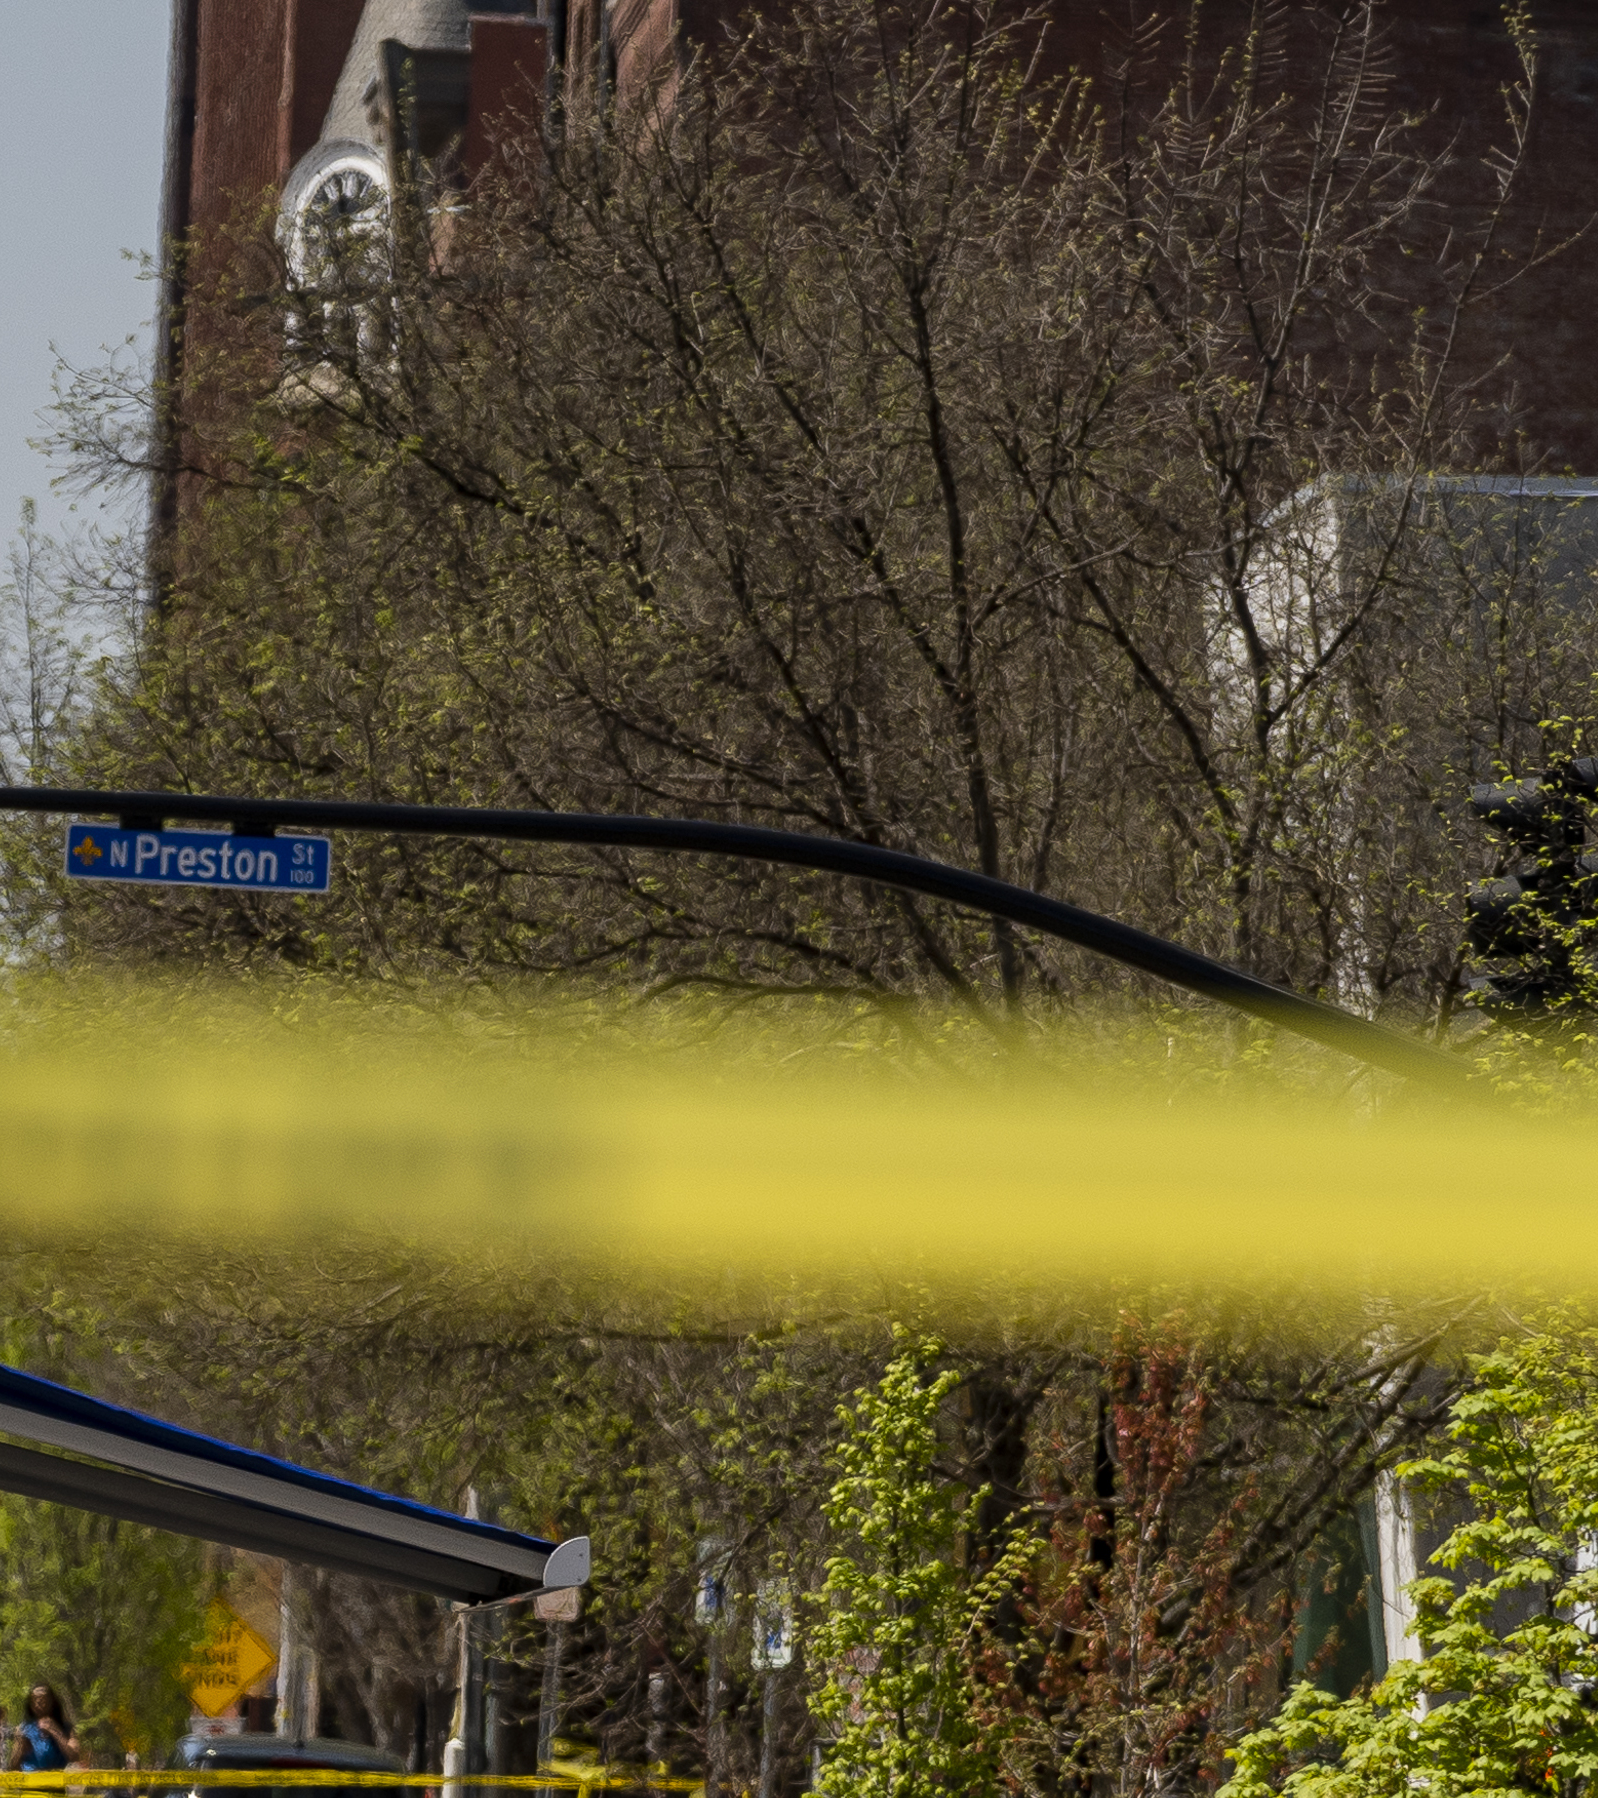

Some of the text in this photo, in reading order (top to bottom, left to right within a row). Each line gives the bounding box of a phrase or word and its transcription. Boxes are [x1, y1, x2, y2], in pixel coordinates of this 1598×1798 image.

[109, 833, 315, 883] N Preston St
